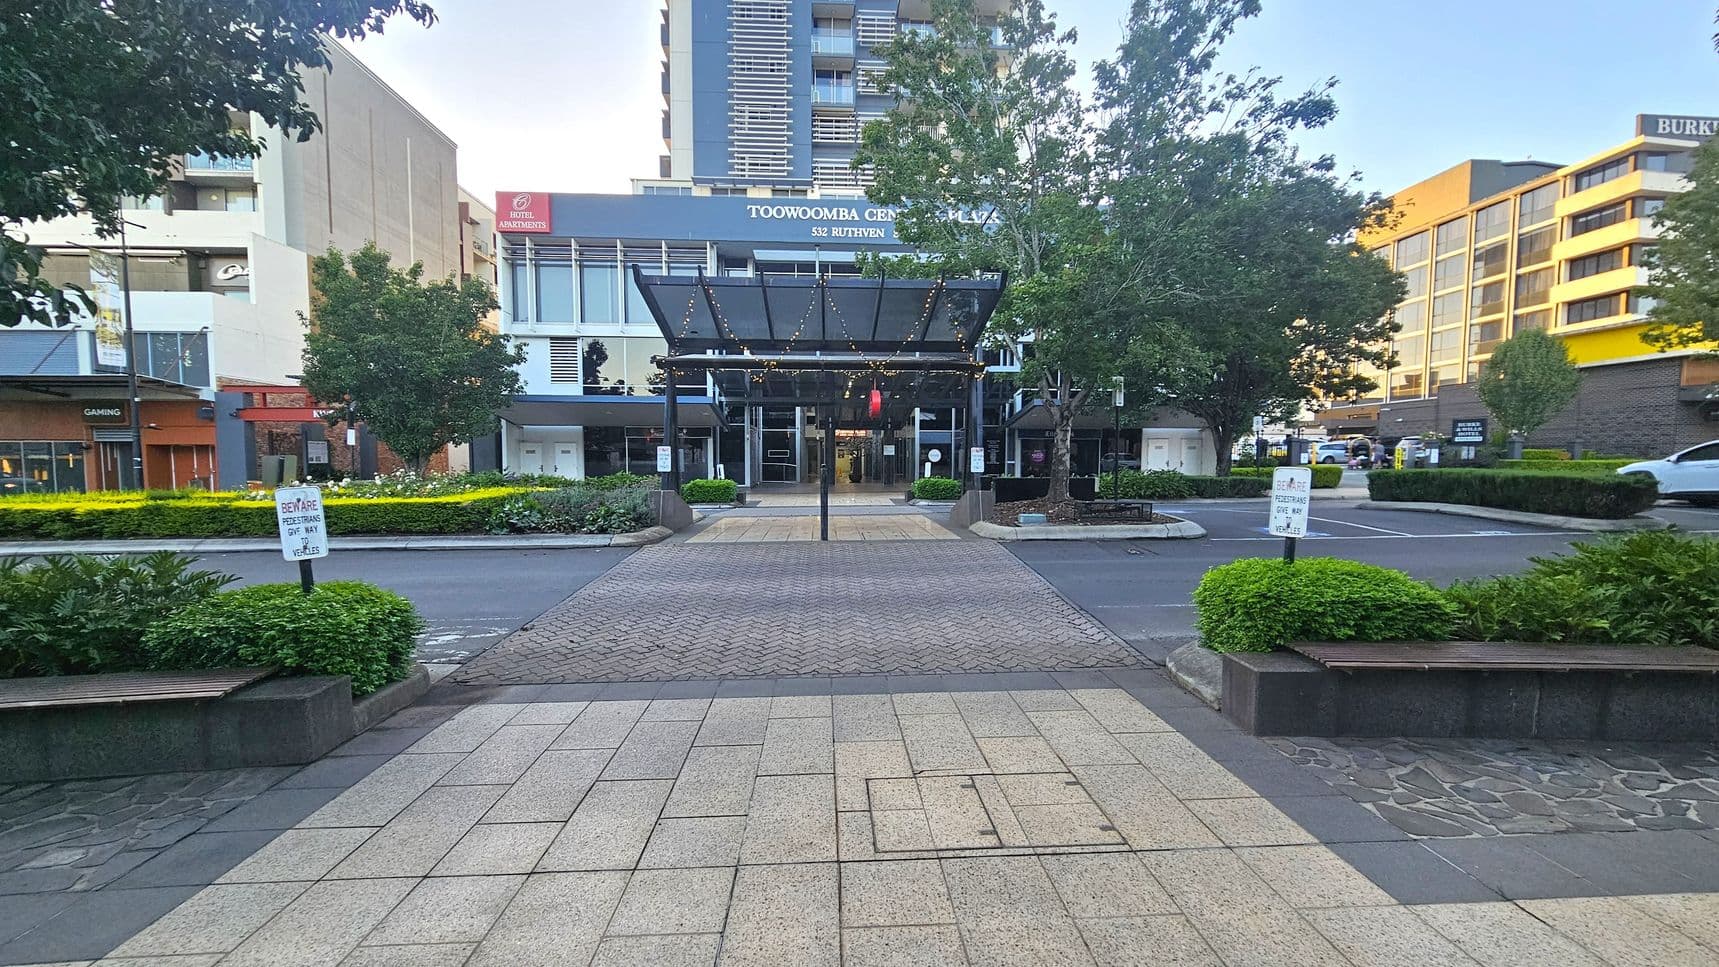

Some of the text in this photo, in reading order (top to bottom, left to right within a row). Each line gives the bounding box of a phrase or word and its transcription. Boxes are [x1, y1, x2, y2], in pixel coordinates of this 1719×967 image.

[510, 211, 534, 219] HOTEL
[747, 204, 859, 221] TOOWOOMBA
[499, 220, 546, 229] APARTMENTS
[811, 227, 828, 237] 532
[831, 227, 885, 238] RUTHVEN
[83, 408, 121, 416] GAMING
[1276, 480, 1307, 492] BEWARE
[1275, 494, 1307, 504] PEDESTRIANS
[281, 500, 319, 514] BEWARE
[1276, 506, 1303, 516] GIVE WAY
[281, 515, 321, 526] PEDESTRIANS
[304, 525, 319, 534] WAY
[301, 537, 310, 545] TO
